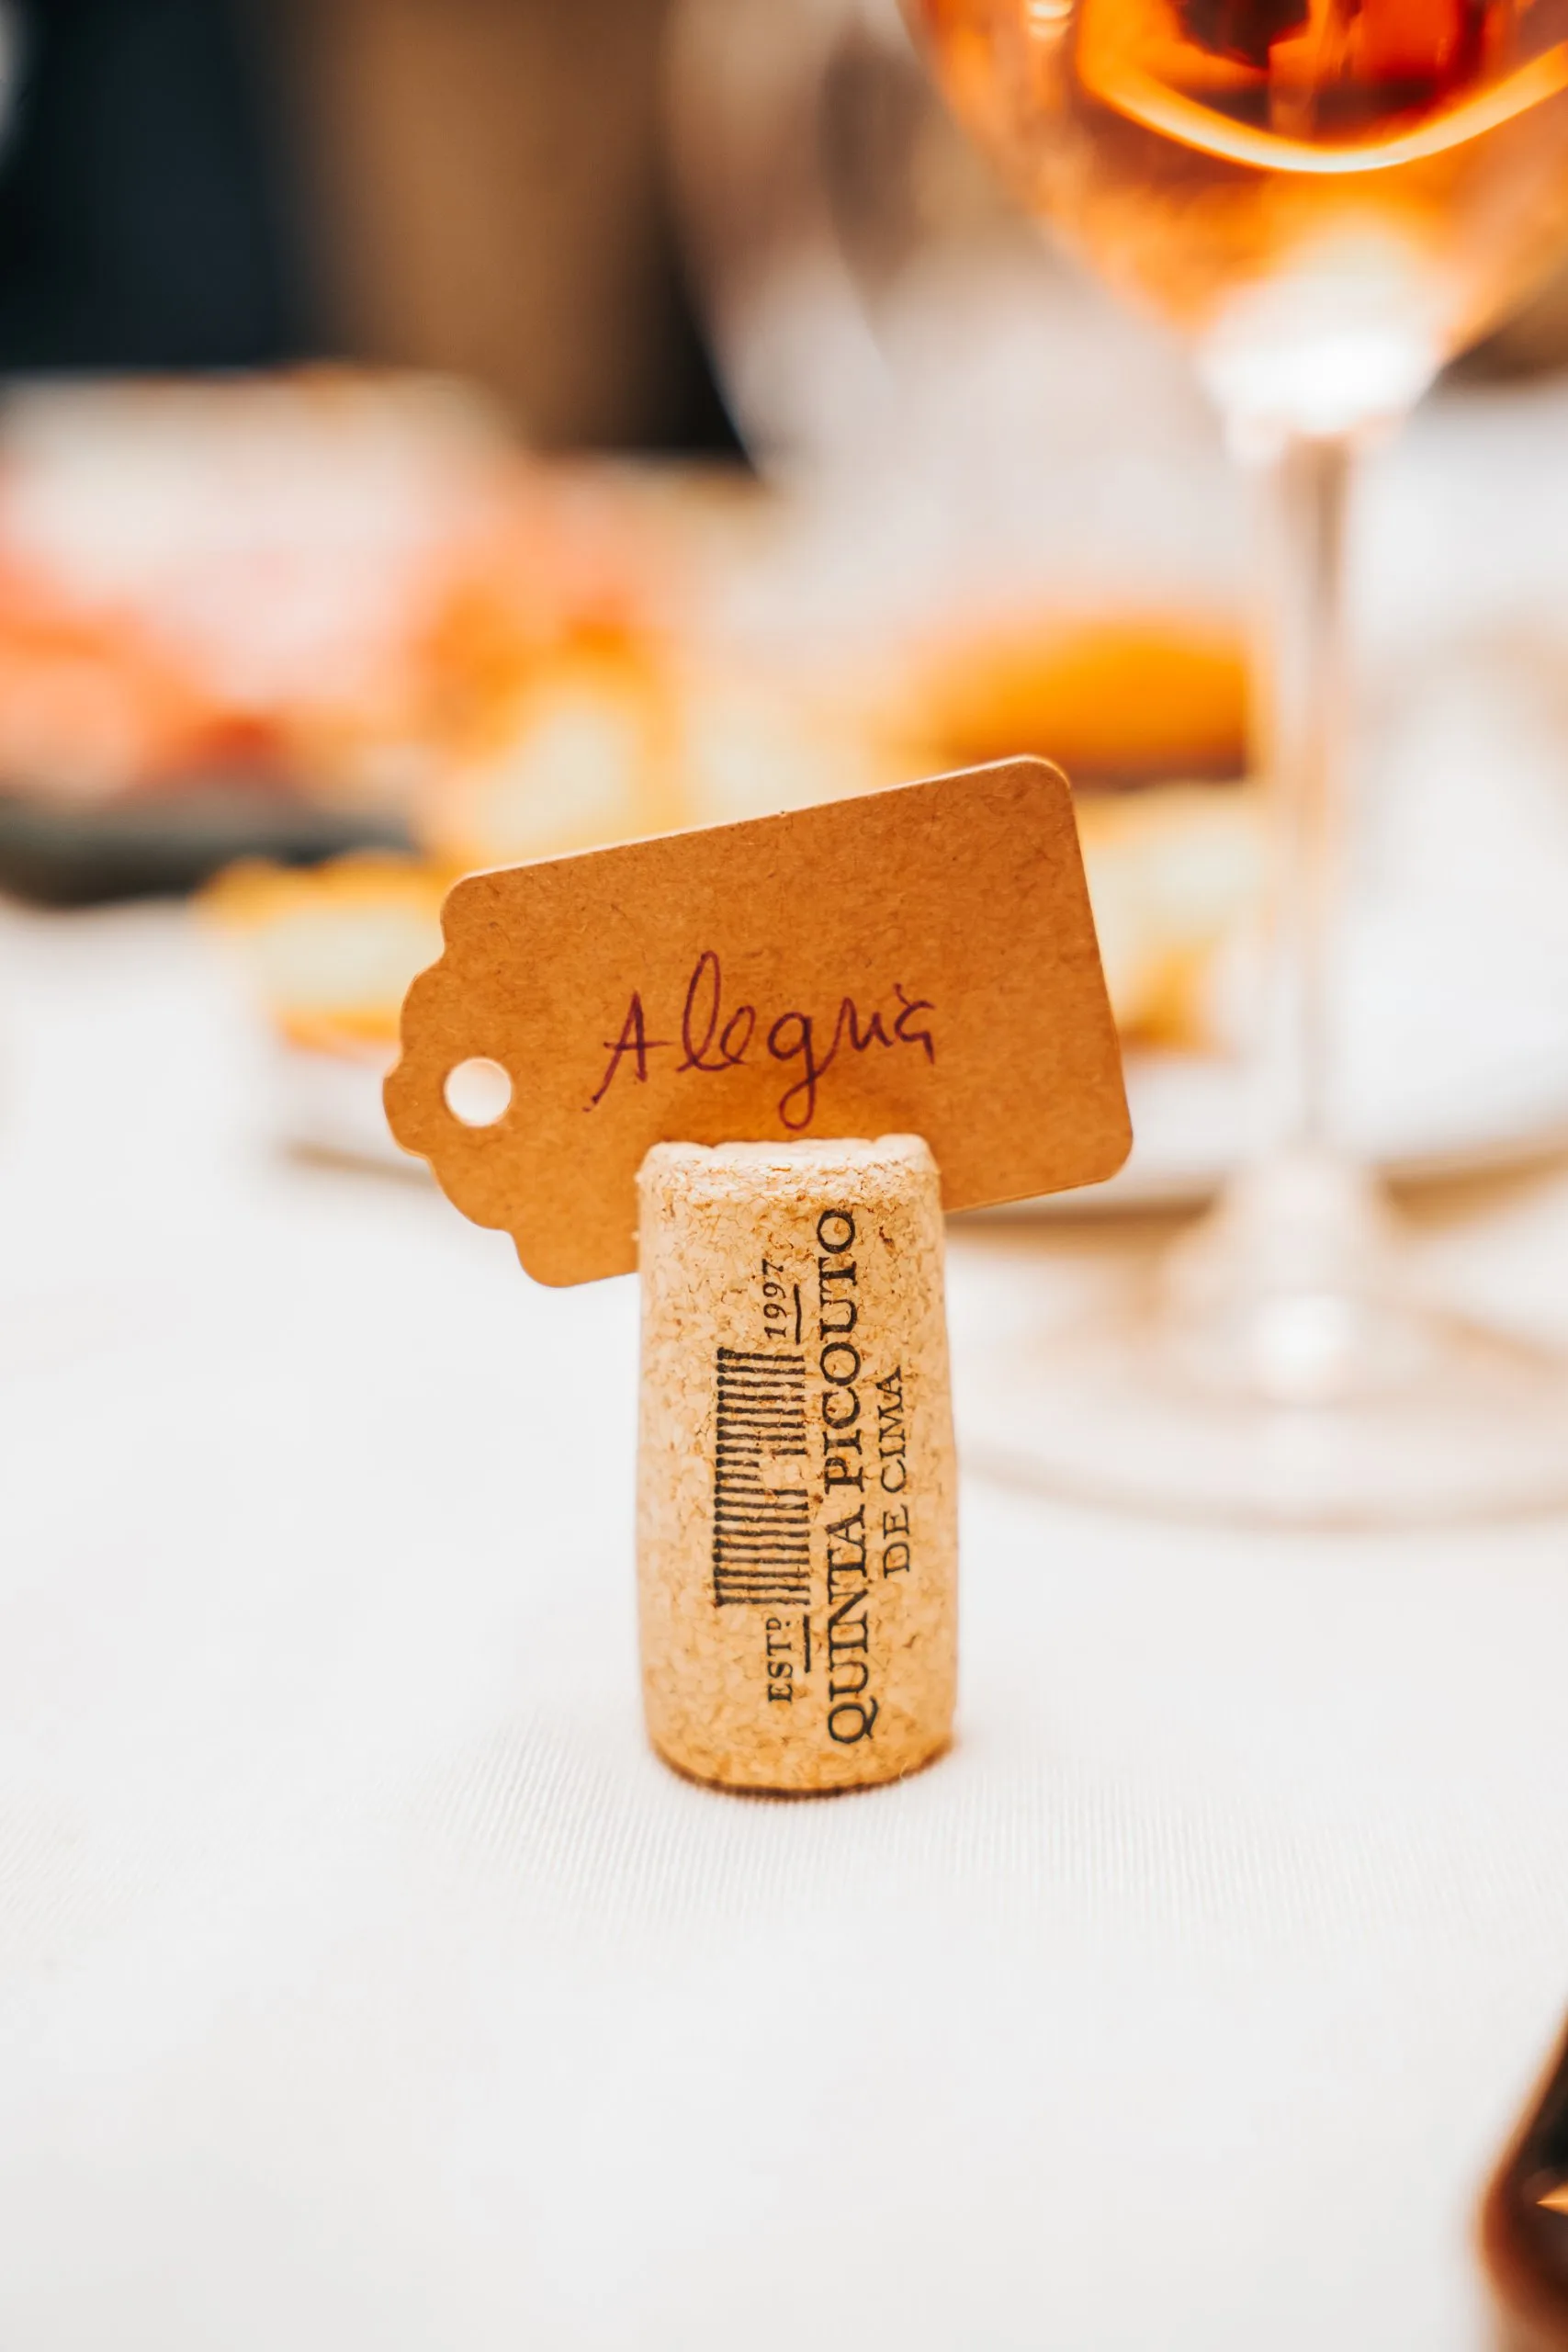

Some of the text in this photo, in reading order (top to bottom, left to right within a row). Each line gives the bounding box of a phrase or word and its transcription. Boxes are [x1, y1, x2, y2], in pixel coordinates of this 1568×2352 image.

[761, 1258, 787, 1339] 1997
[817, 1208, 878, 1744] QUINTA PICOUTO
[876, 1365, 910, 1578] DE CIMA
